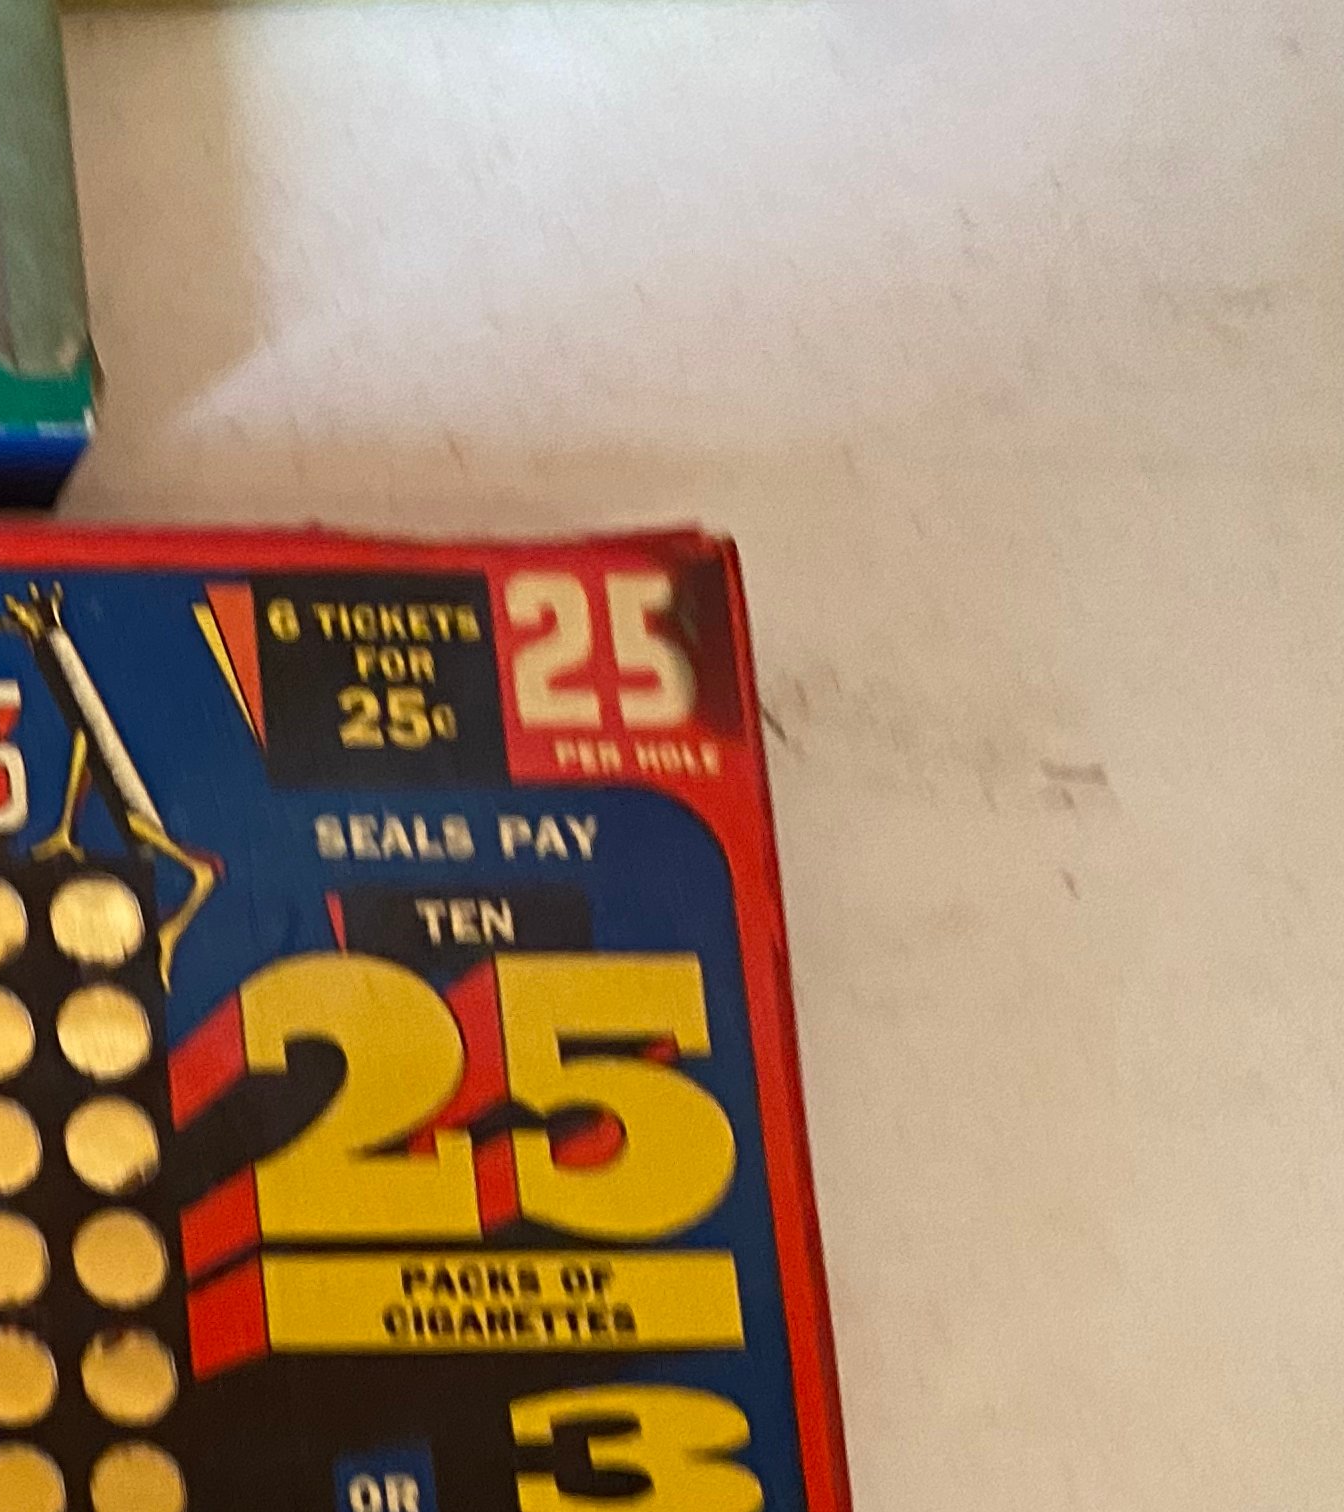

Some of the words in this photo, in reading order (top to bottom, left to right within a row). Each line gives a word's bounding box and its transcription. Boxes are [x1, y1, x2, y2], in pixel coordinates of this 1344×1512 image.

[267, 597, 301, 644] 6
[313, 602, 481, 643] TICKETS
[355, 644, 436, 686] FOR
[505, 572, 696, 729] 25
[555, 738, 622, 774] PER
[634, 739, 721, 776] HOLE
[315, 814, 475, 862] SEALS
[499, 814, 598, 861] PAY
[415, 898, 516, 945] TEN
[239, 951, 737, 1242] 25
[400, 1262, 543, 1299] PACKS
[561, 1262, 615, 1298] OF
[382, 1304, 637, 1343] CIGARETTES
